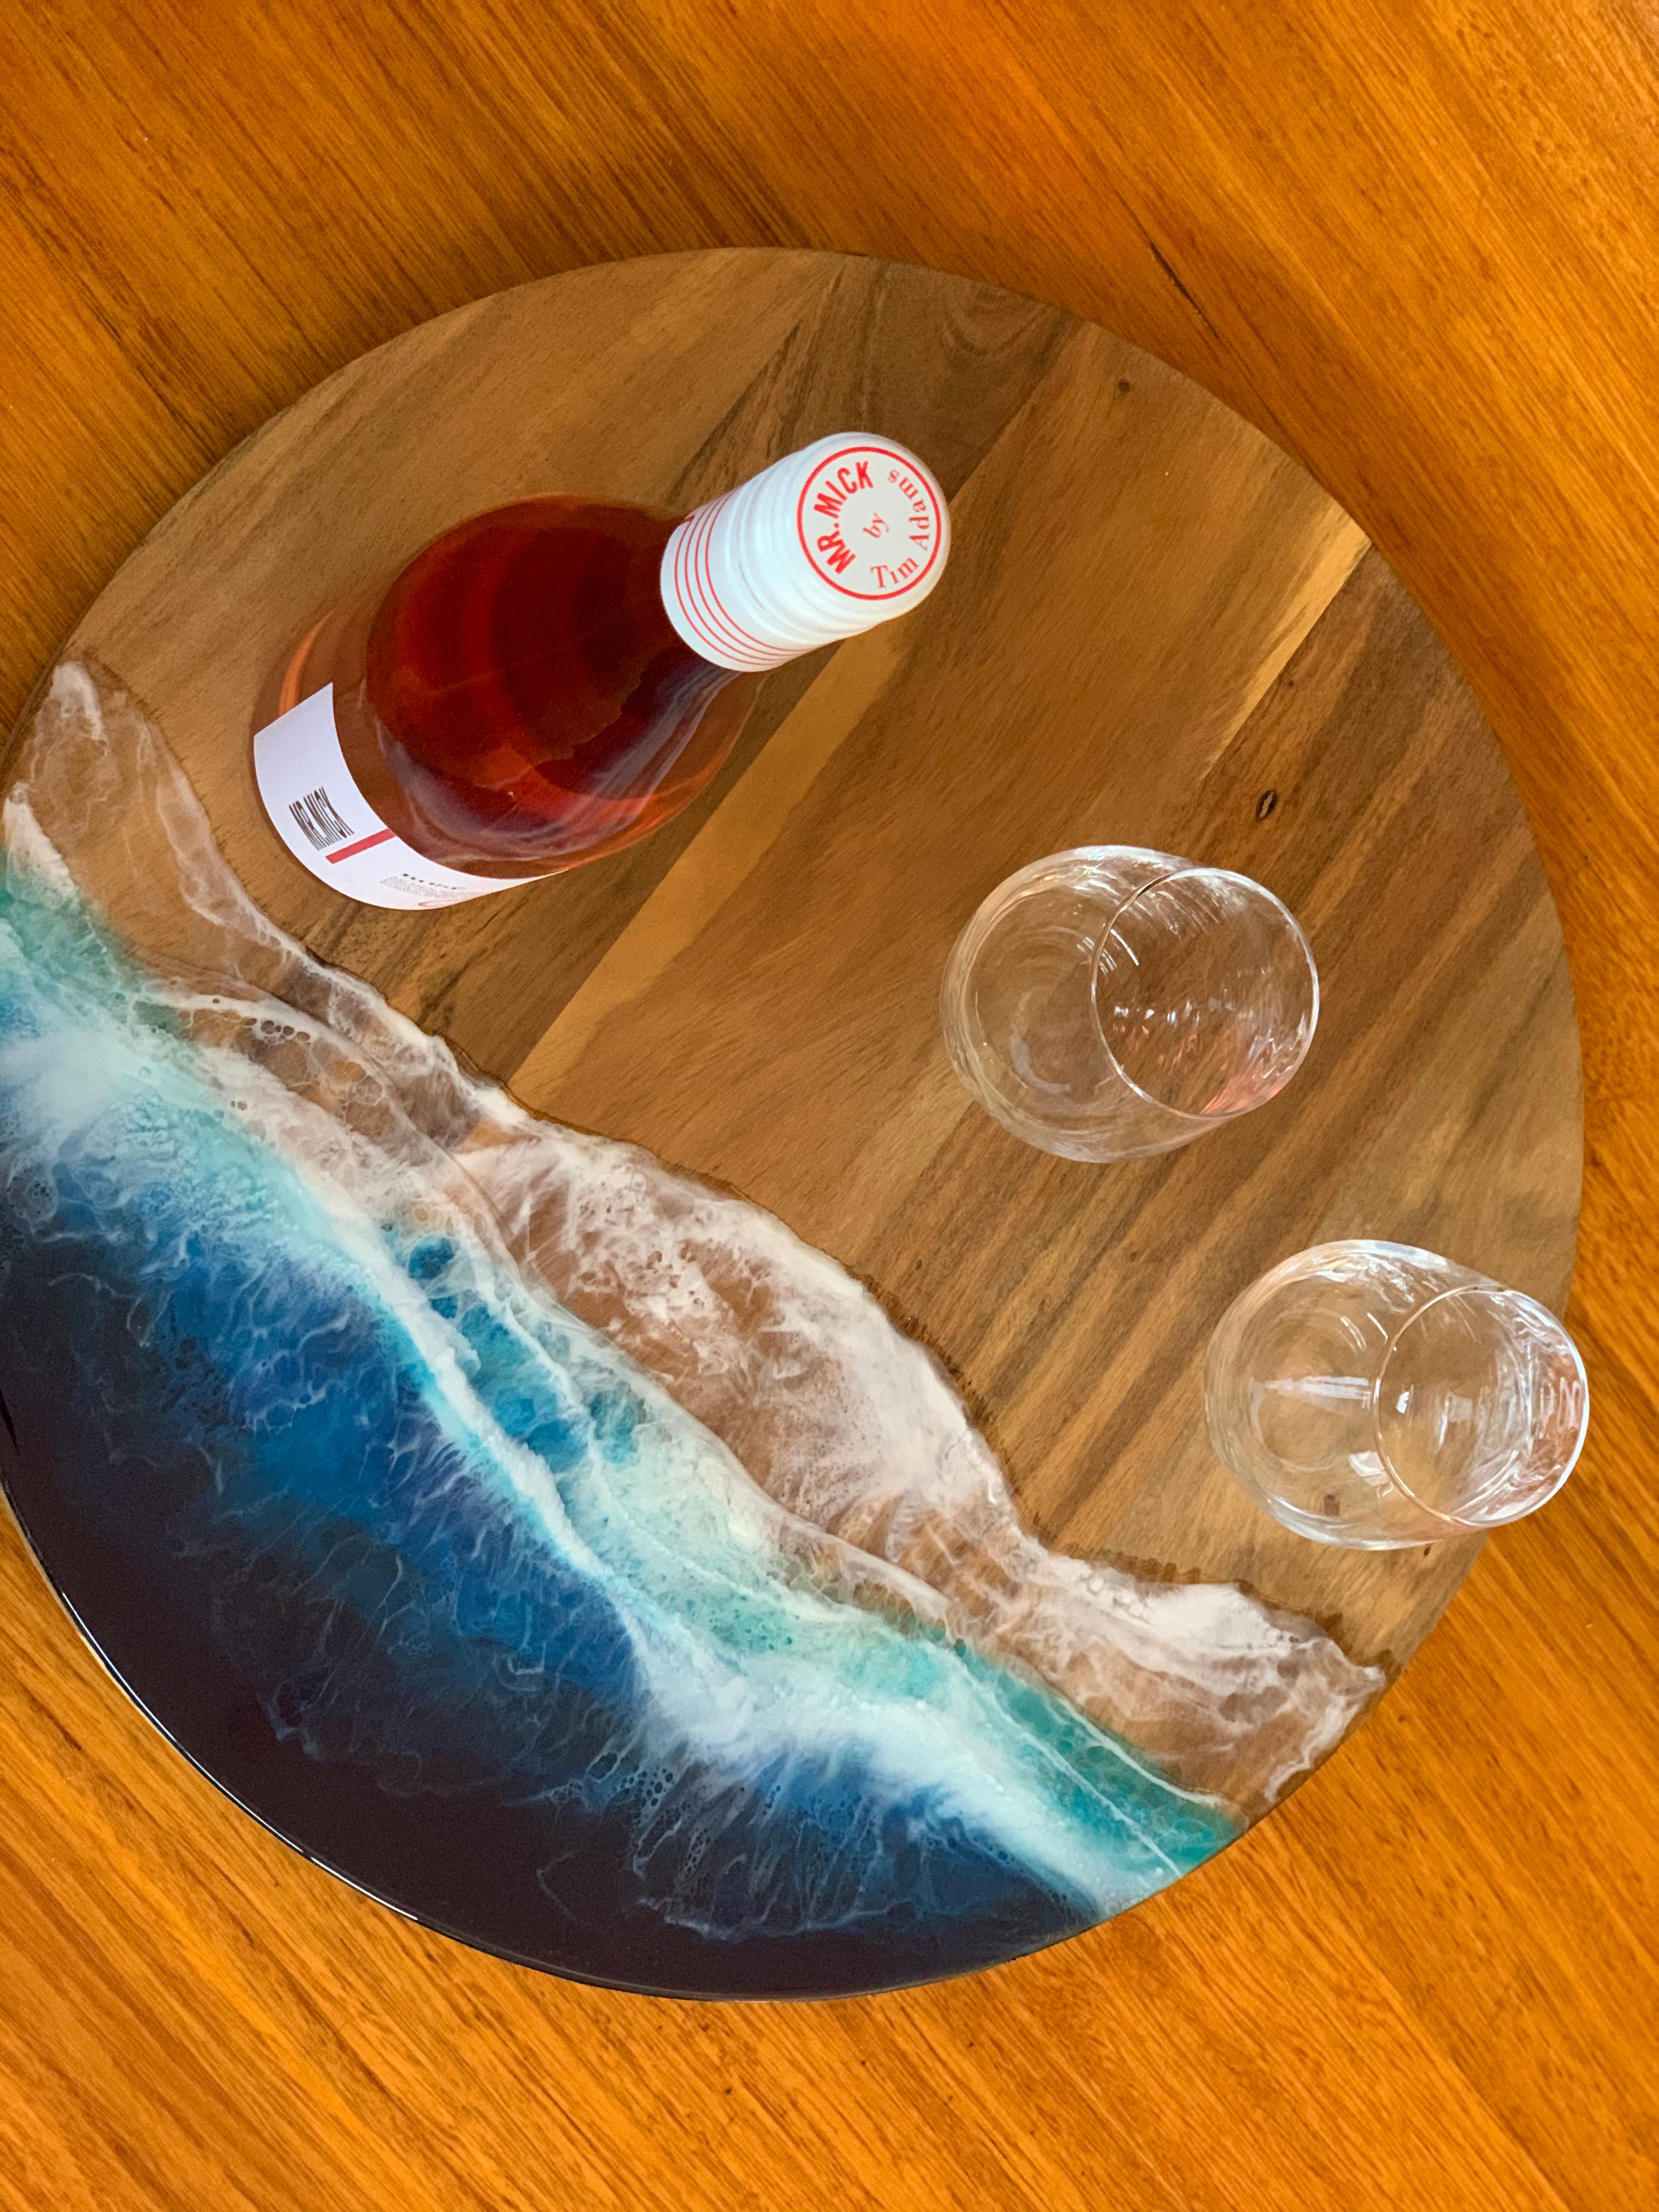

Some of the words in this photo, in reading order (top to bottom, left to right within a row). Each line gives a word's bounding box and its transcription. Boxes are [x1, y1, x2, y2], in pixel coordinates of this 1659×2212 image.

[813, 460, 874, 520] MICK
[888, 469, 930, 550] Adams
[862, 512, 889, 539] by
[870, 557, 919, 589] Tim
